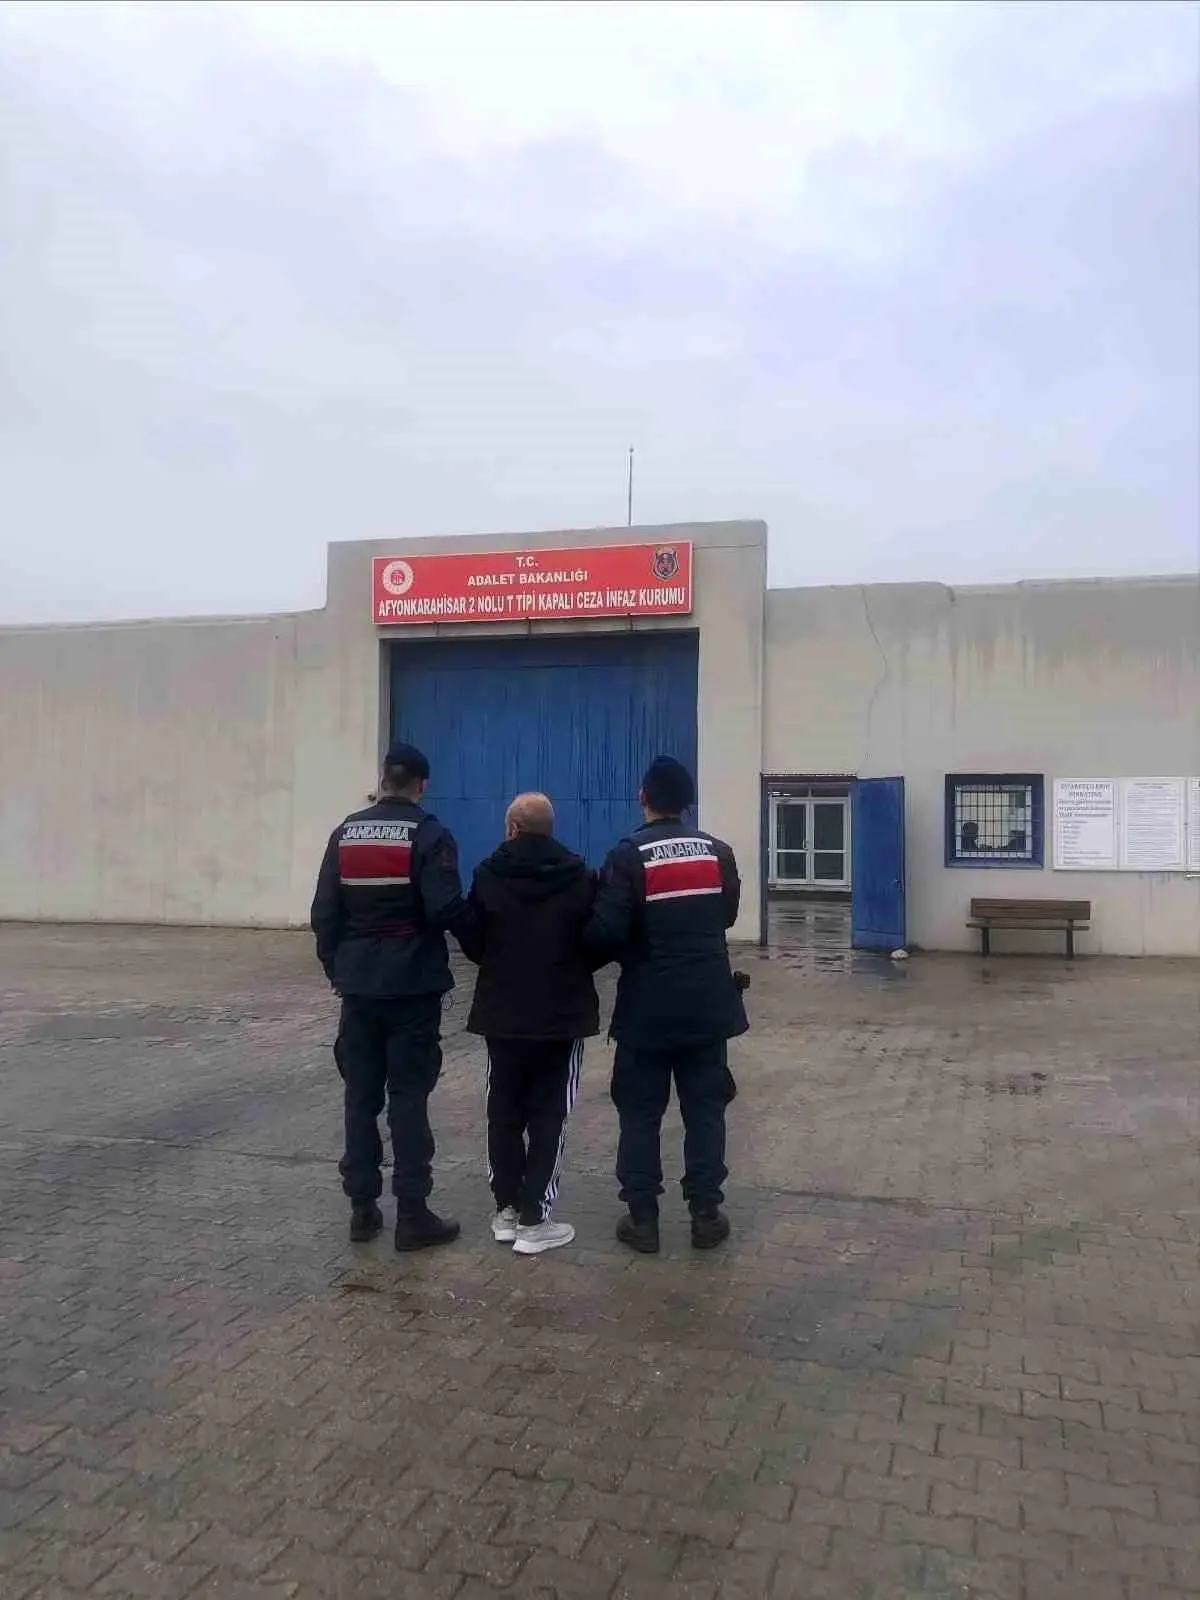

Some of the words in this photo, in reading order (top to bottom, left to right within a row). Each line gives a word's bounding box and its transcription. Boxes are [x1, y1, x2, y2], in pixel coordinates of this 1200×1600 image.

[516, 556, 539, 567] T.C.
[467, 574, 515, 586] ADALET
[519, 570, 588, 584] BAKANLIĞI
[378, 593, 465, 616] AFYONKARAHİSAR
[469, 599, 475, 613] 2
[477, 595, 504, 613] NOLU
[506, 596, 513, 611] T
[515, 590, 536, 611] TİPİ
[538, 592, 574, 610] KAPALI
[576, 591, 603, 609] CEZA
[606, 587, 636, 607] İNFAZ
[639, 587, 685, 606] KURUMU
[342, 825, 409, 840] JANDARMA
[650, 843, 710, 860] JANDARMA
